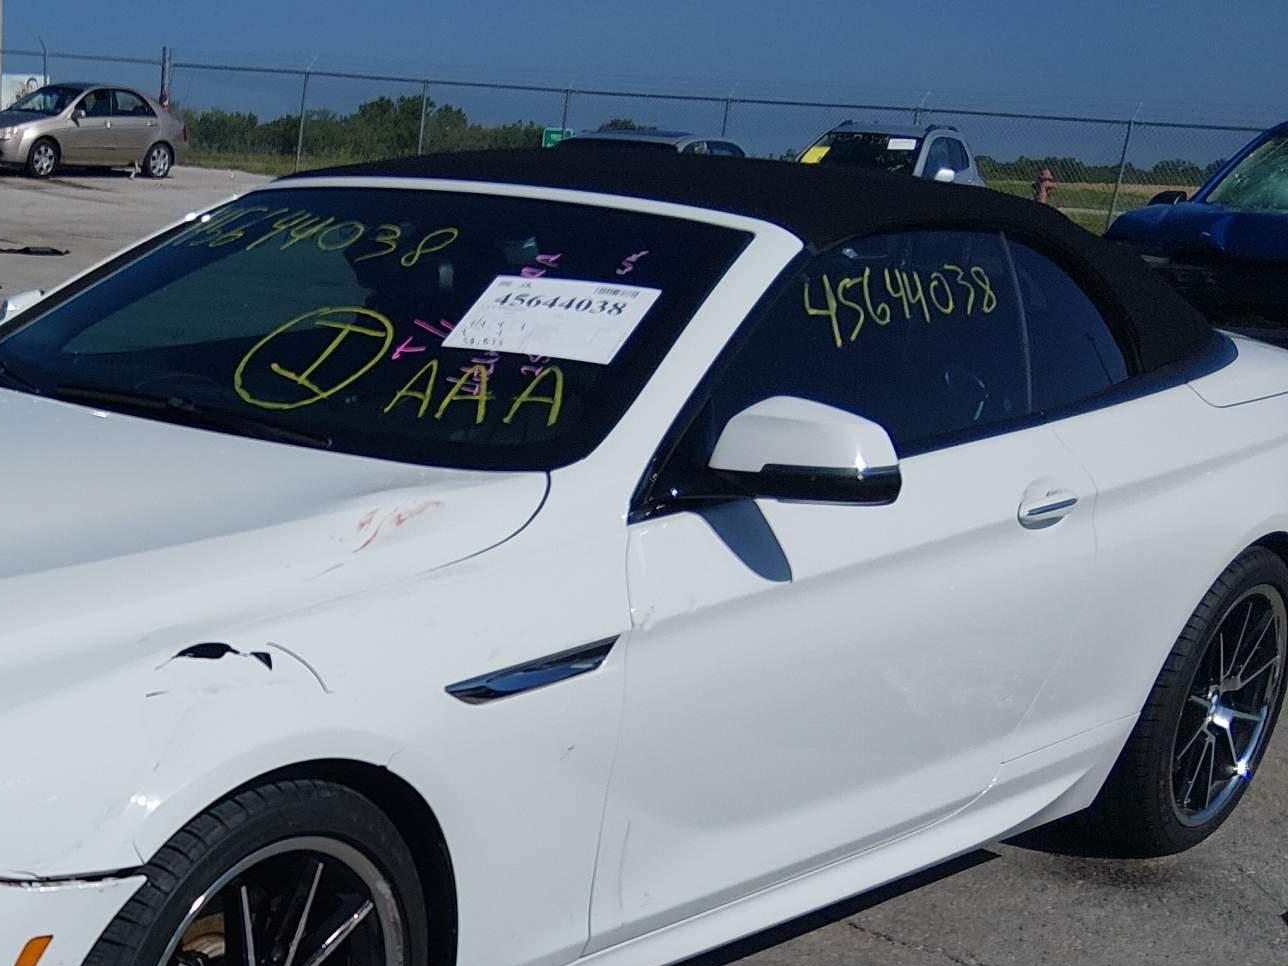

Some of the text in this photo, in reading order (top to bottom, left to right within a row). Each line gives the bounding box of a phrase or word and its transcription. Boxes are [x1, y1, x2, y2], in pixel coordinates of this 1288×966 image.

[495, 292, 627, 317] 45644038
[804, 264, 997, 348] 45644038
[383, 359, 563, 426] AAA
